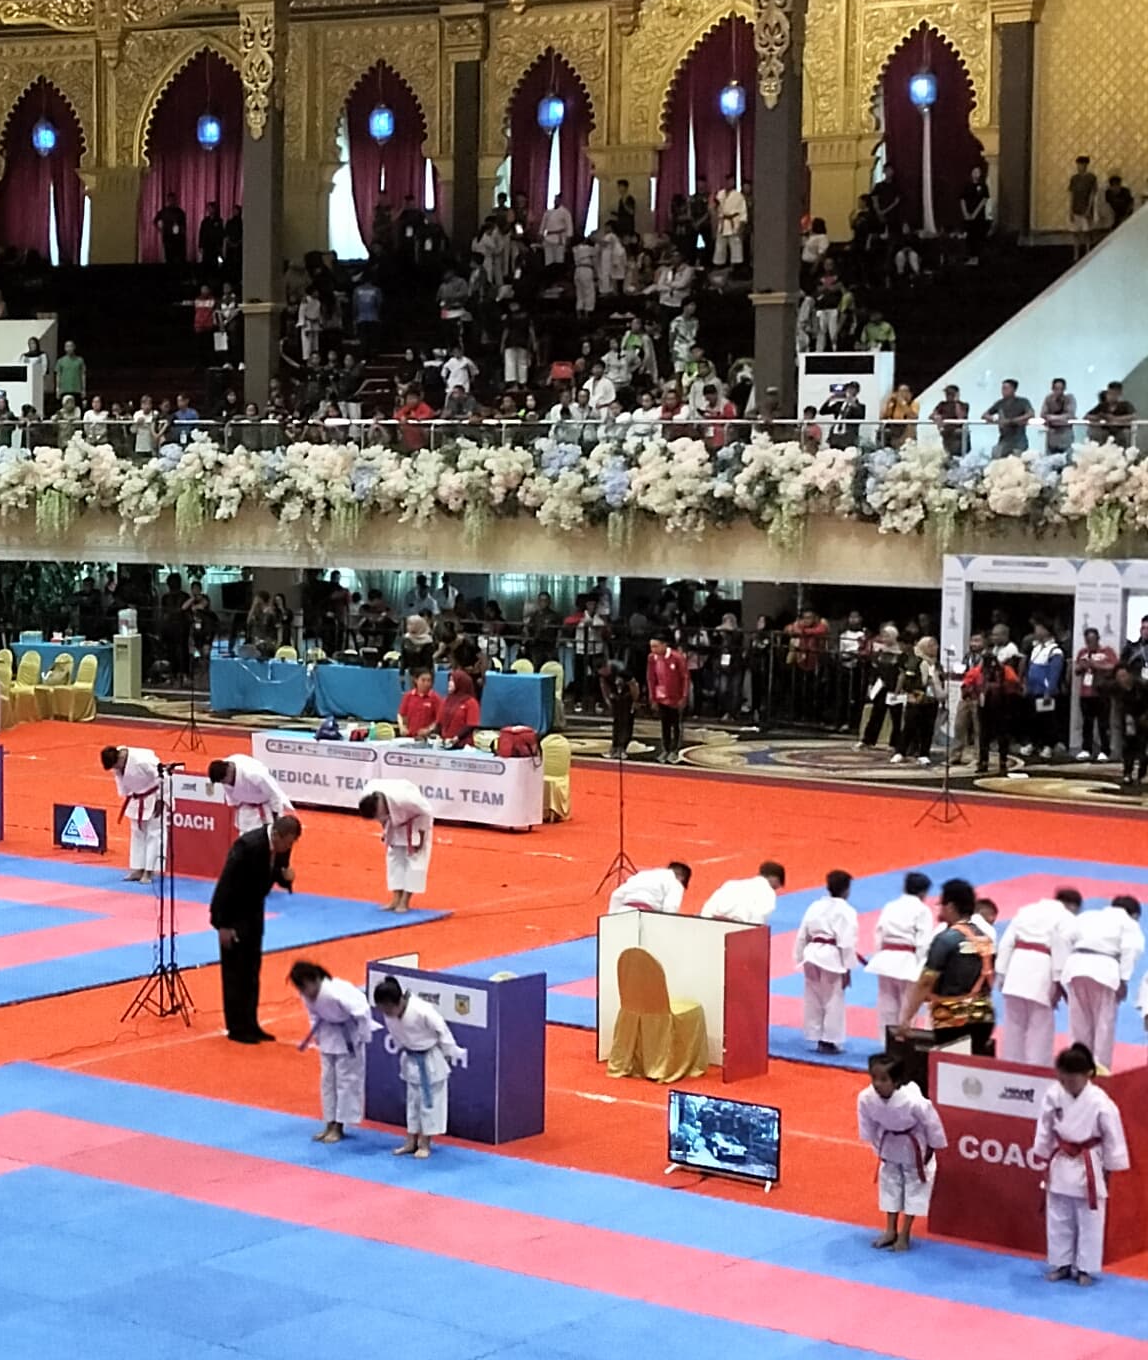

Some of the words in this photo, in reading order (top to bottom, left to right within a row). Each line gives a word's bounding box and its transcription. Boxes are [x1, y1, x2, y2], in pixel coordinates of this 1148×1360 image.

[335, 775, 368, 791] TEA
[459, 788, 504, 806] TEAM
[958, 1135, 1048, 1171] COAC
